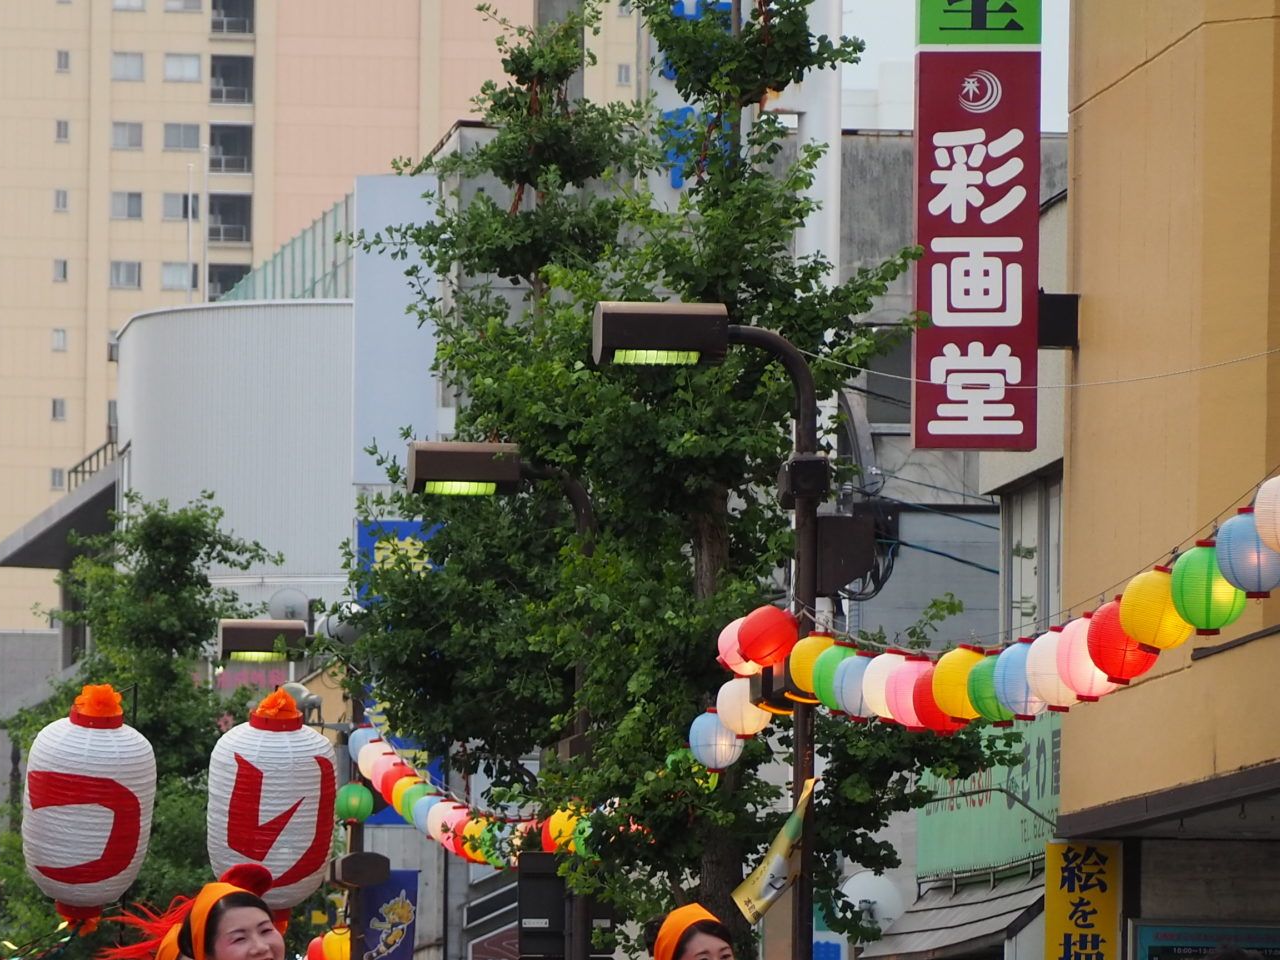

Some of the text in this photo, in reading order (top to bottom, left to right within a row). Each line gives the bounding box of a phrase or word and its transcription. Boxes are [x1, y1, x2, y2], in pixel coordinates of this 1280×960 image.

[926, 127, 1024, 436] 彩画堂
[26, 770, 142, 885] つ
[226, 752, 337, 889] り
